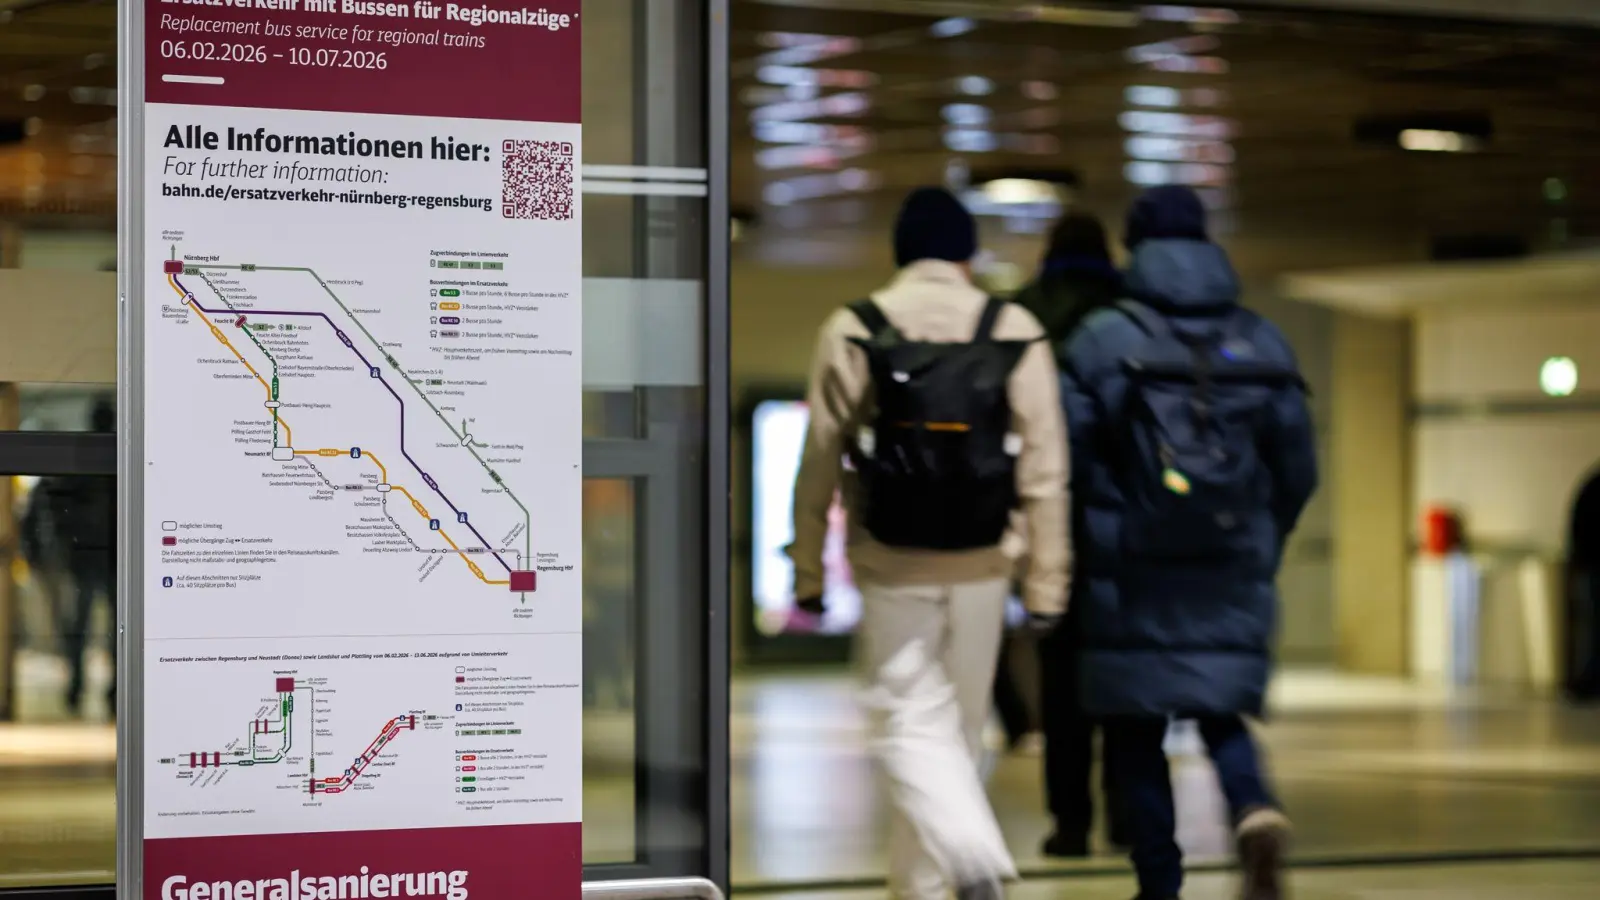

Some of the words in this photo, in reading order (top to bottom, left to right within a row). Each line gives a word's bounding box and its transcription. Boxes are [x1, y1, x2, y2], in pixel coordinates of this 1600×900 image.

[304, 0, 337, 14] mit
[341, 0, 409, 17] Bussen
[414, 1, 442, 20] für
[446, 4, 570, 31] Regionalzüge
[160, 14, 260, 34] Replacement
[265, 20, 292, 37] bus
[296, 24, 348, 40] service
[351, 25, 374, 44] for
[377, 28, 439, 46] regional
[443, 32, 486, 48] trains
[160, 40, 267, 63] 06.02.2026
[289, 48, 388, 69] 10.07.2026
[164, 124, 219, 150] Alle
[228, 127, 423, 159] Informationen
[431, 136, 490, 162] hier:
[164, 156, 196, 176] For
[201, 157, 268, 180] further
[273, 160, 388, 184] information:
[162, 183, 492, 212] bahn.de/ersatzverkehr-nürnberg-regensburg
[430, 250, 470, 258] Zugverbindungen
[161, 866, 468, 900] Generalsanierung
